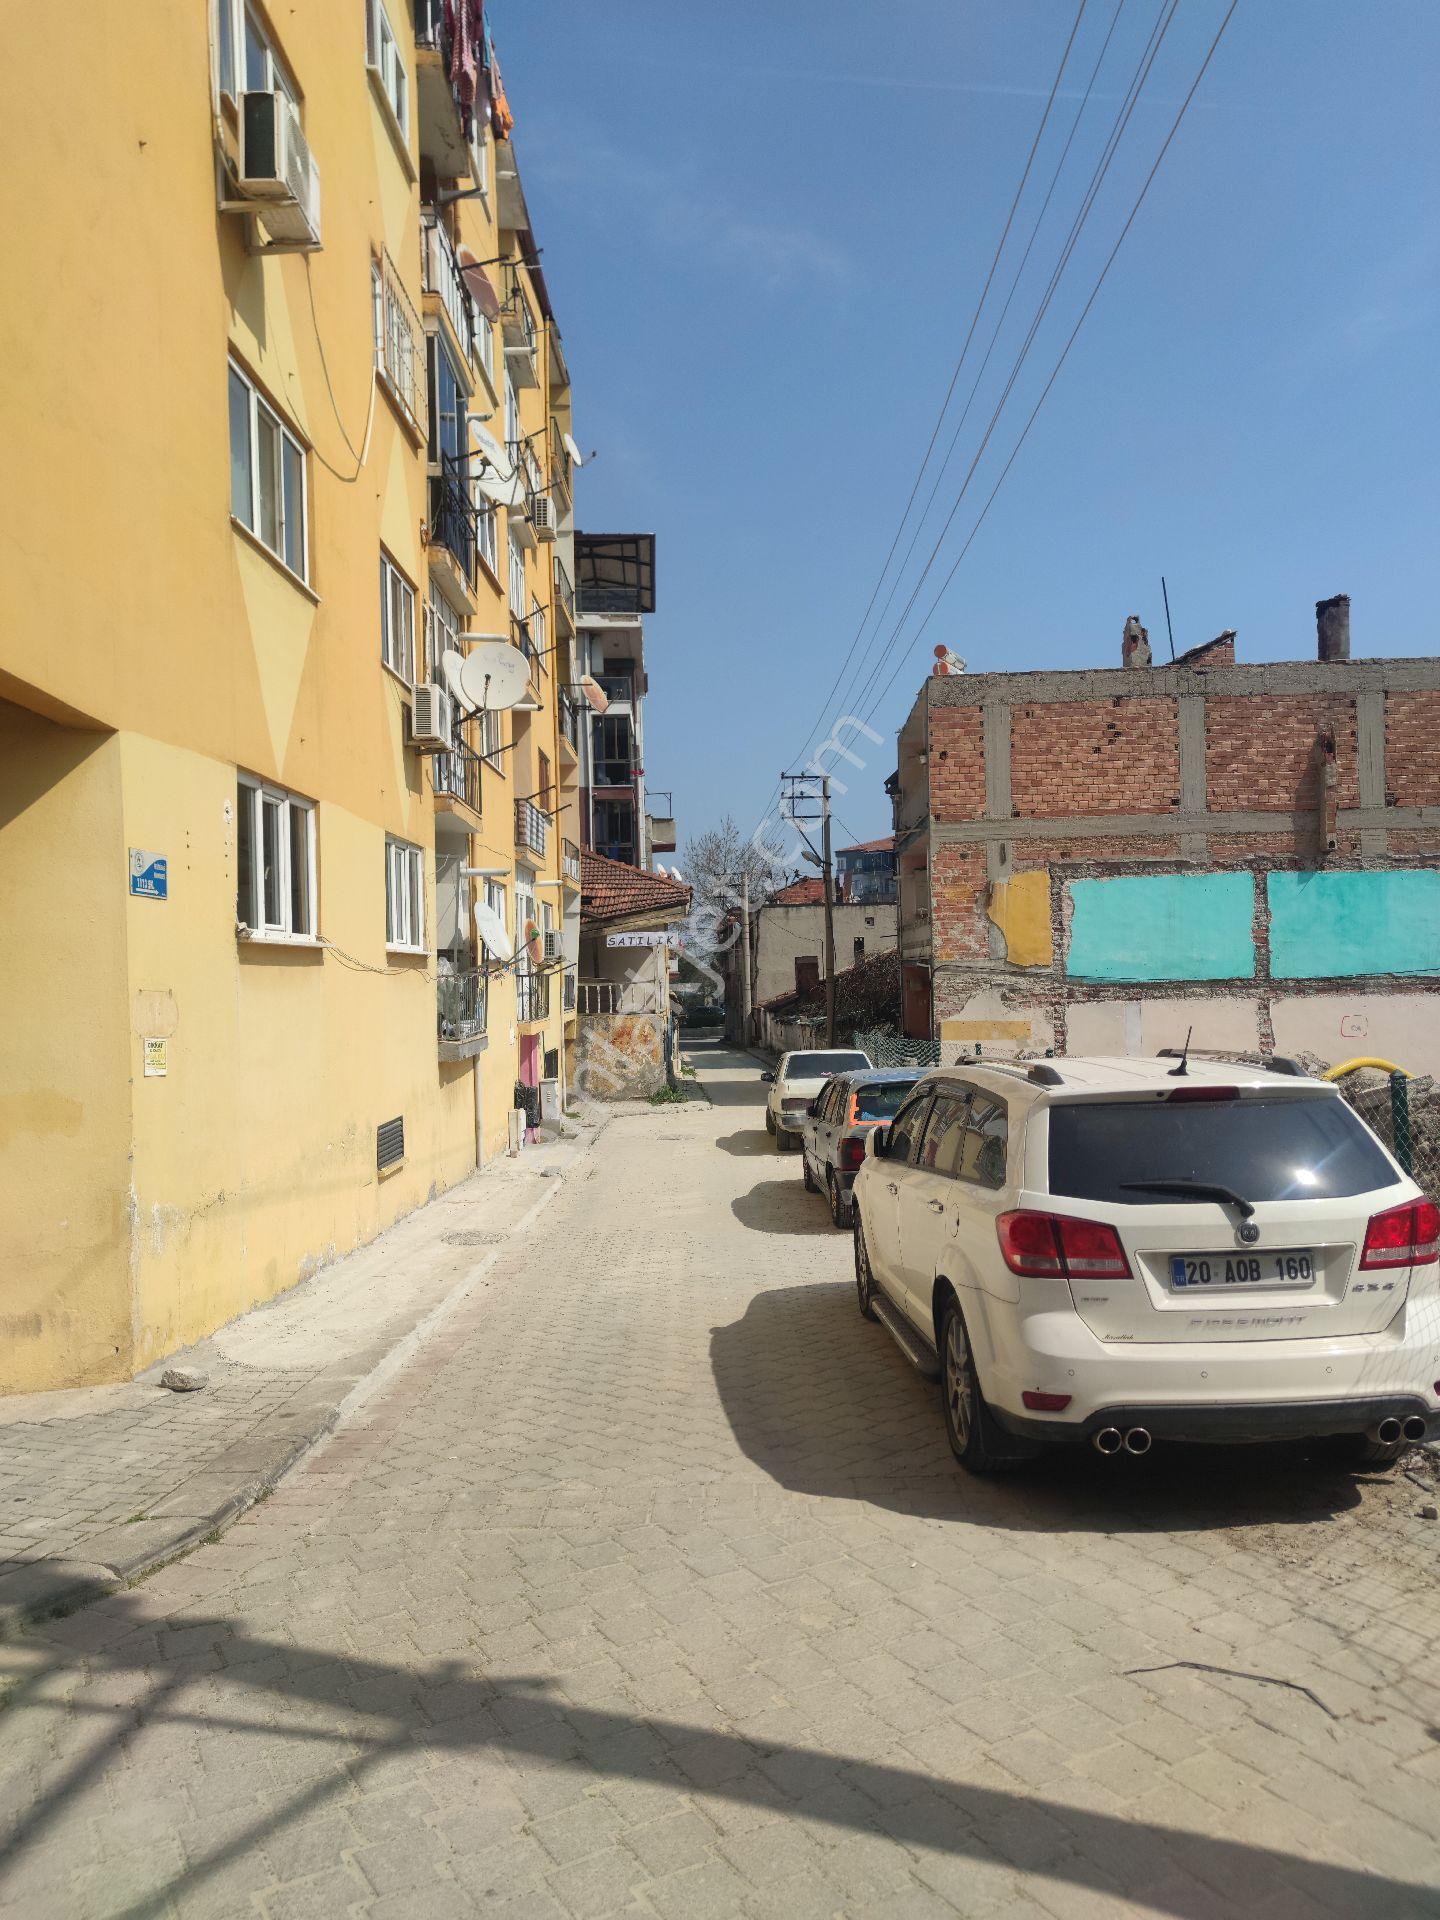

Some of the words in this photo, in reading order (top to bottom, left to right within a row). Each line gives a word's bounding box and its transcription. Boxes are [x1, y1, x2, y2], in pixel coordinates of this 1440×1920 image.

[607, 935, 674, 946] SATILIK
[1186, 1261, 1211, 1284] 20
[1225, 1259, 1261, 1283] AOB
[1276, 1257, 1311, 1280] 160
